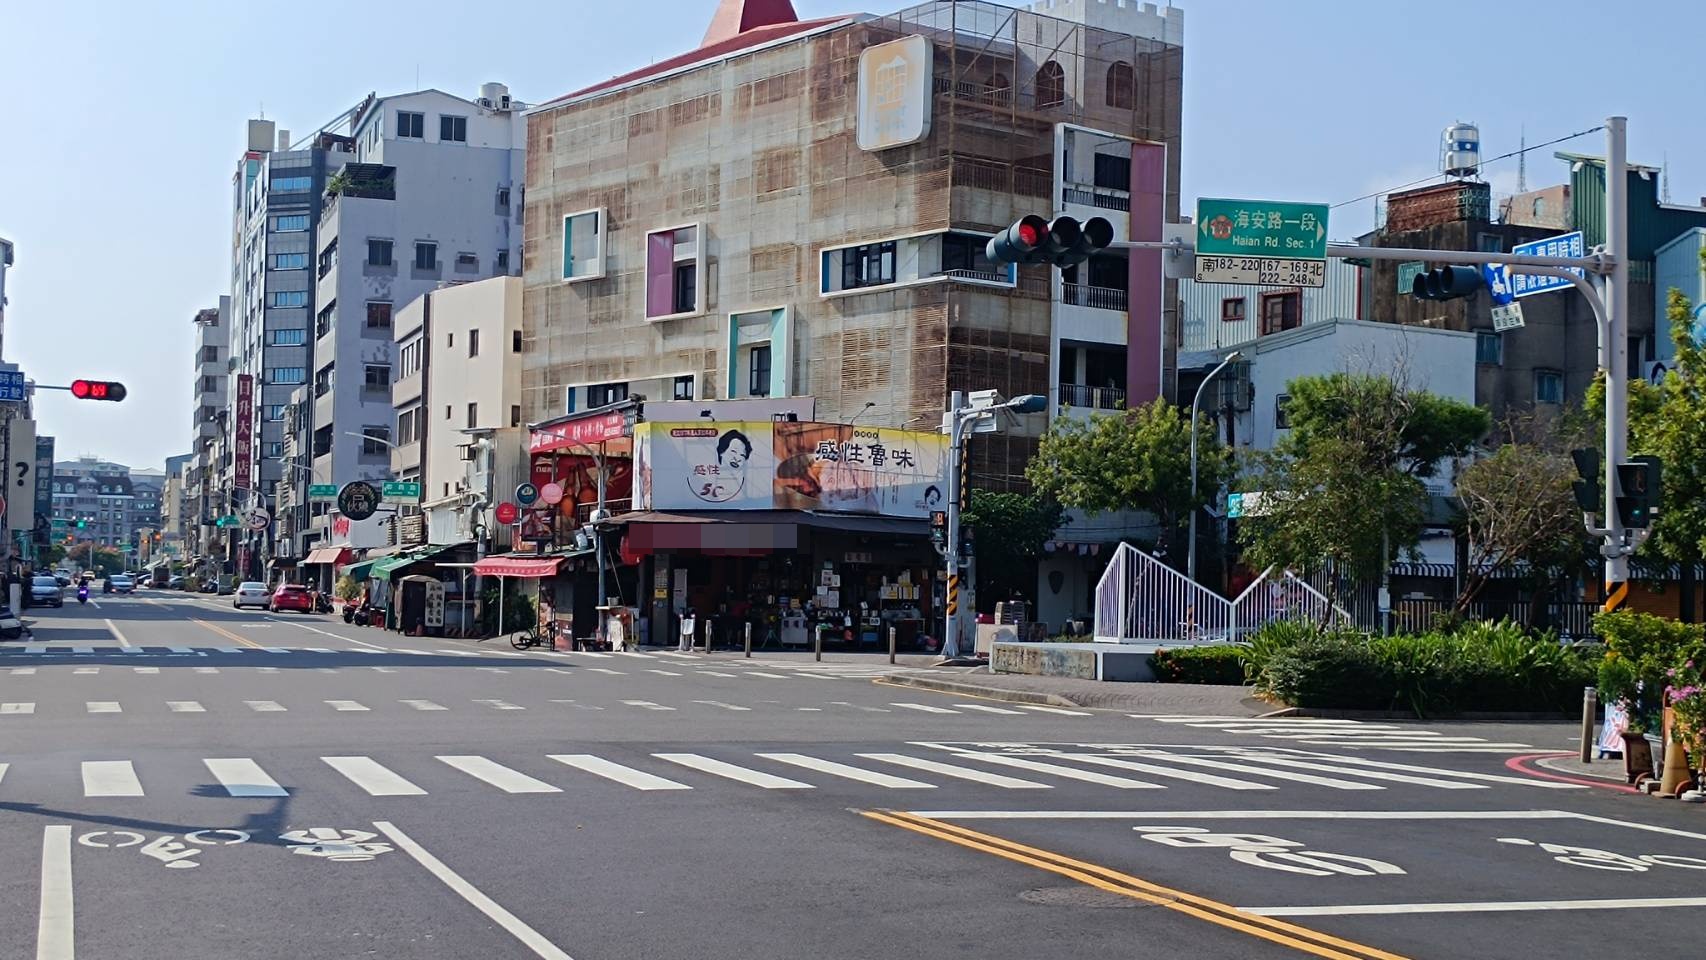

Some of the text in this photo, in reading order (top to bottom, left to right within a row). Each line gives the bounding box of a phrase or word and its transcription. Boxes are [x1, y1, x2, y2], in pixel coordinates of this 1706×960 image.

[1234, 209, 1316, 231] 海安路一段
[1232, 235, 1260, 246] Haian
[1264, 236, 1280, 247] Rd.
[1202, 258, 1215, 272] 南
[1309, 263, 1323, 276] 北
[236, 380, 251, 476] 日升大飯店
[815, 440, 915, 469] 感性魯味
